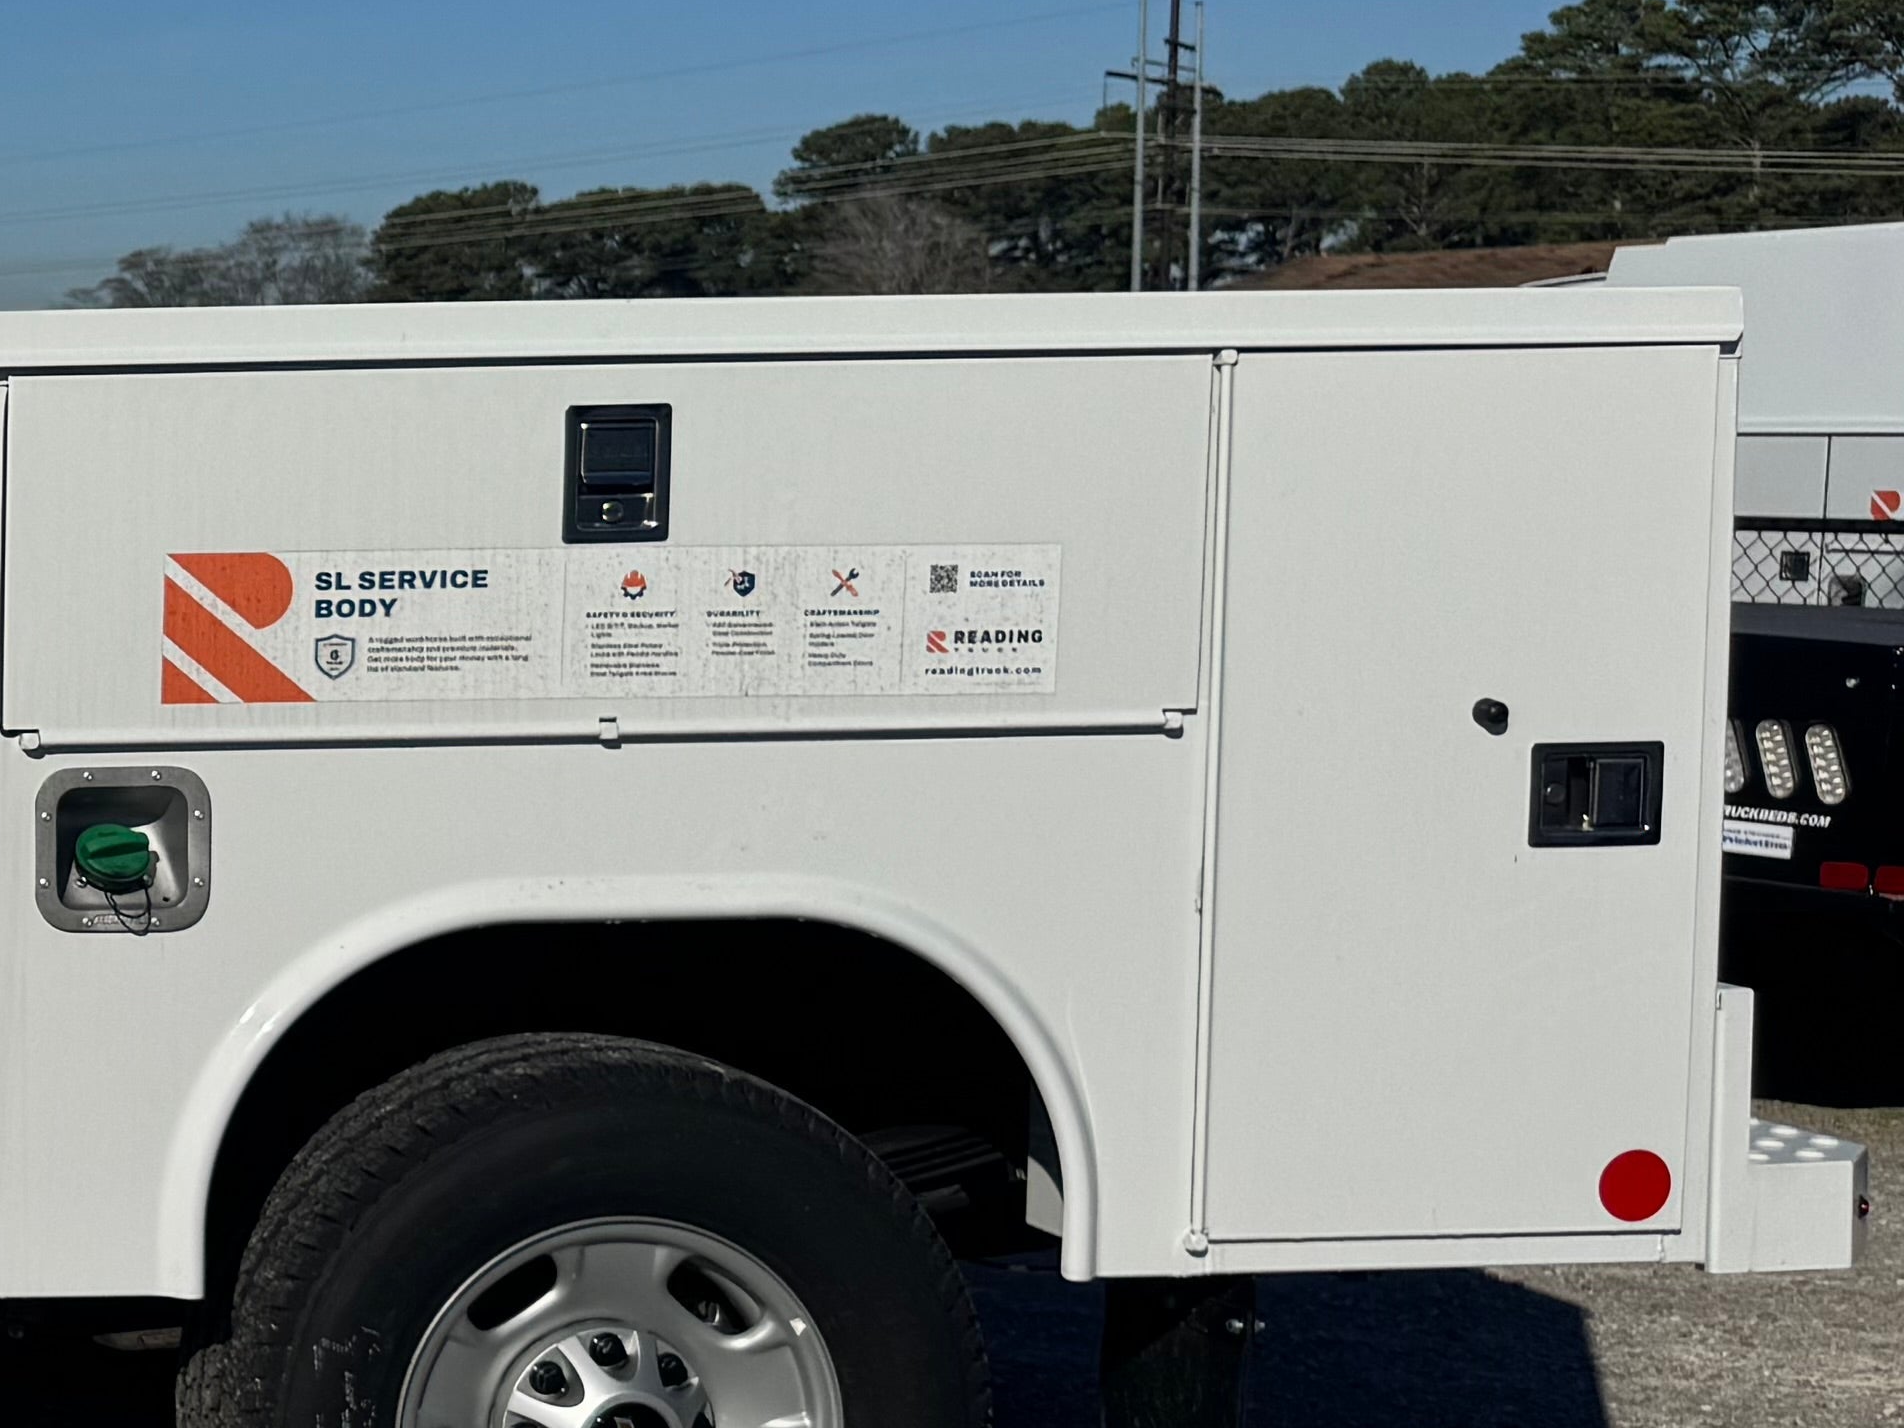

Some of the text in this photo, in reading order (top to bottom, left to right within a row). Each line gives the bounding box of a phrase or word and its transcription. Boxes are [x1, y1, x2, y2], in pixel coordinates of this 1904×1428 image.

[314, 569, 489, 591] SL SERVICE
[1000, 570, 1022, 578] FOR
[969, 579, 1045, 588] MORE DETAILS
[314, 597, 398, 619] BODY
[953, 629, 1044, 644] READING
